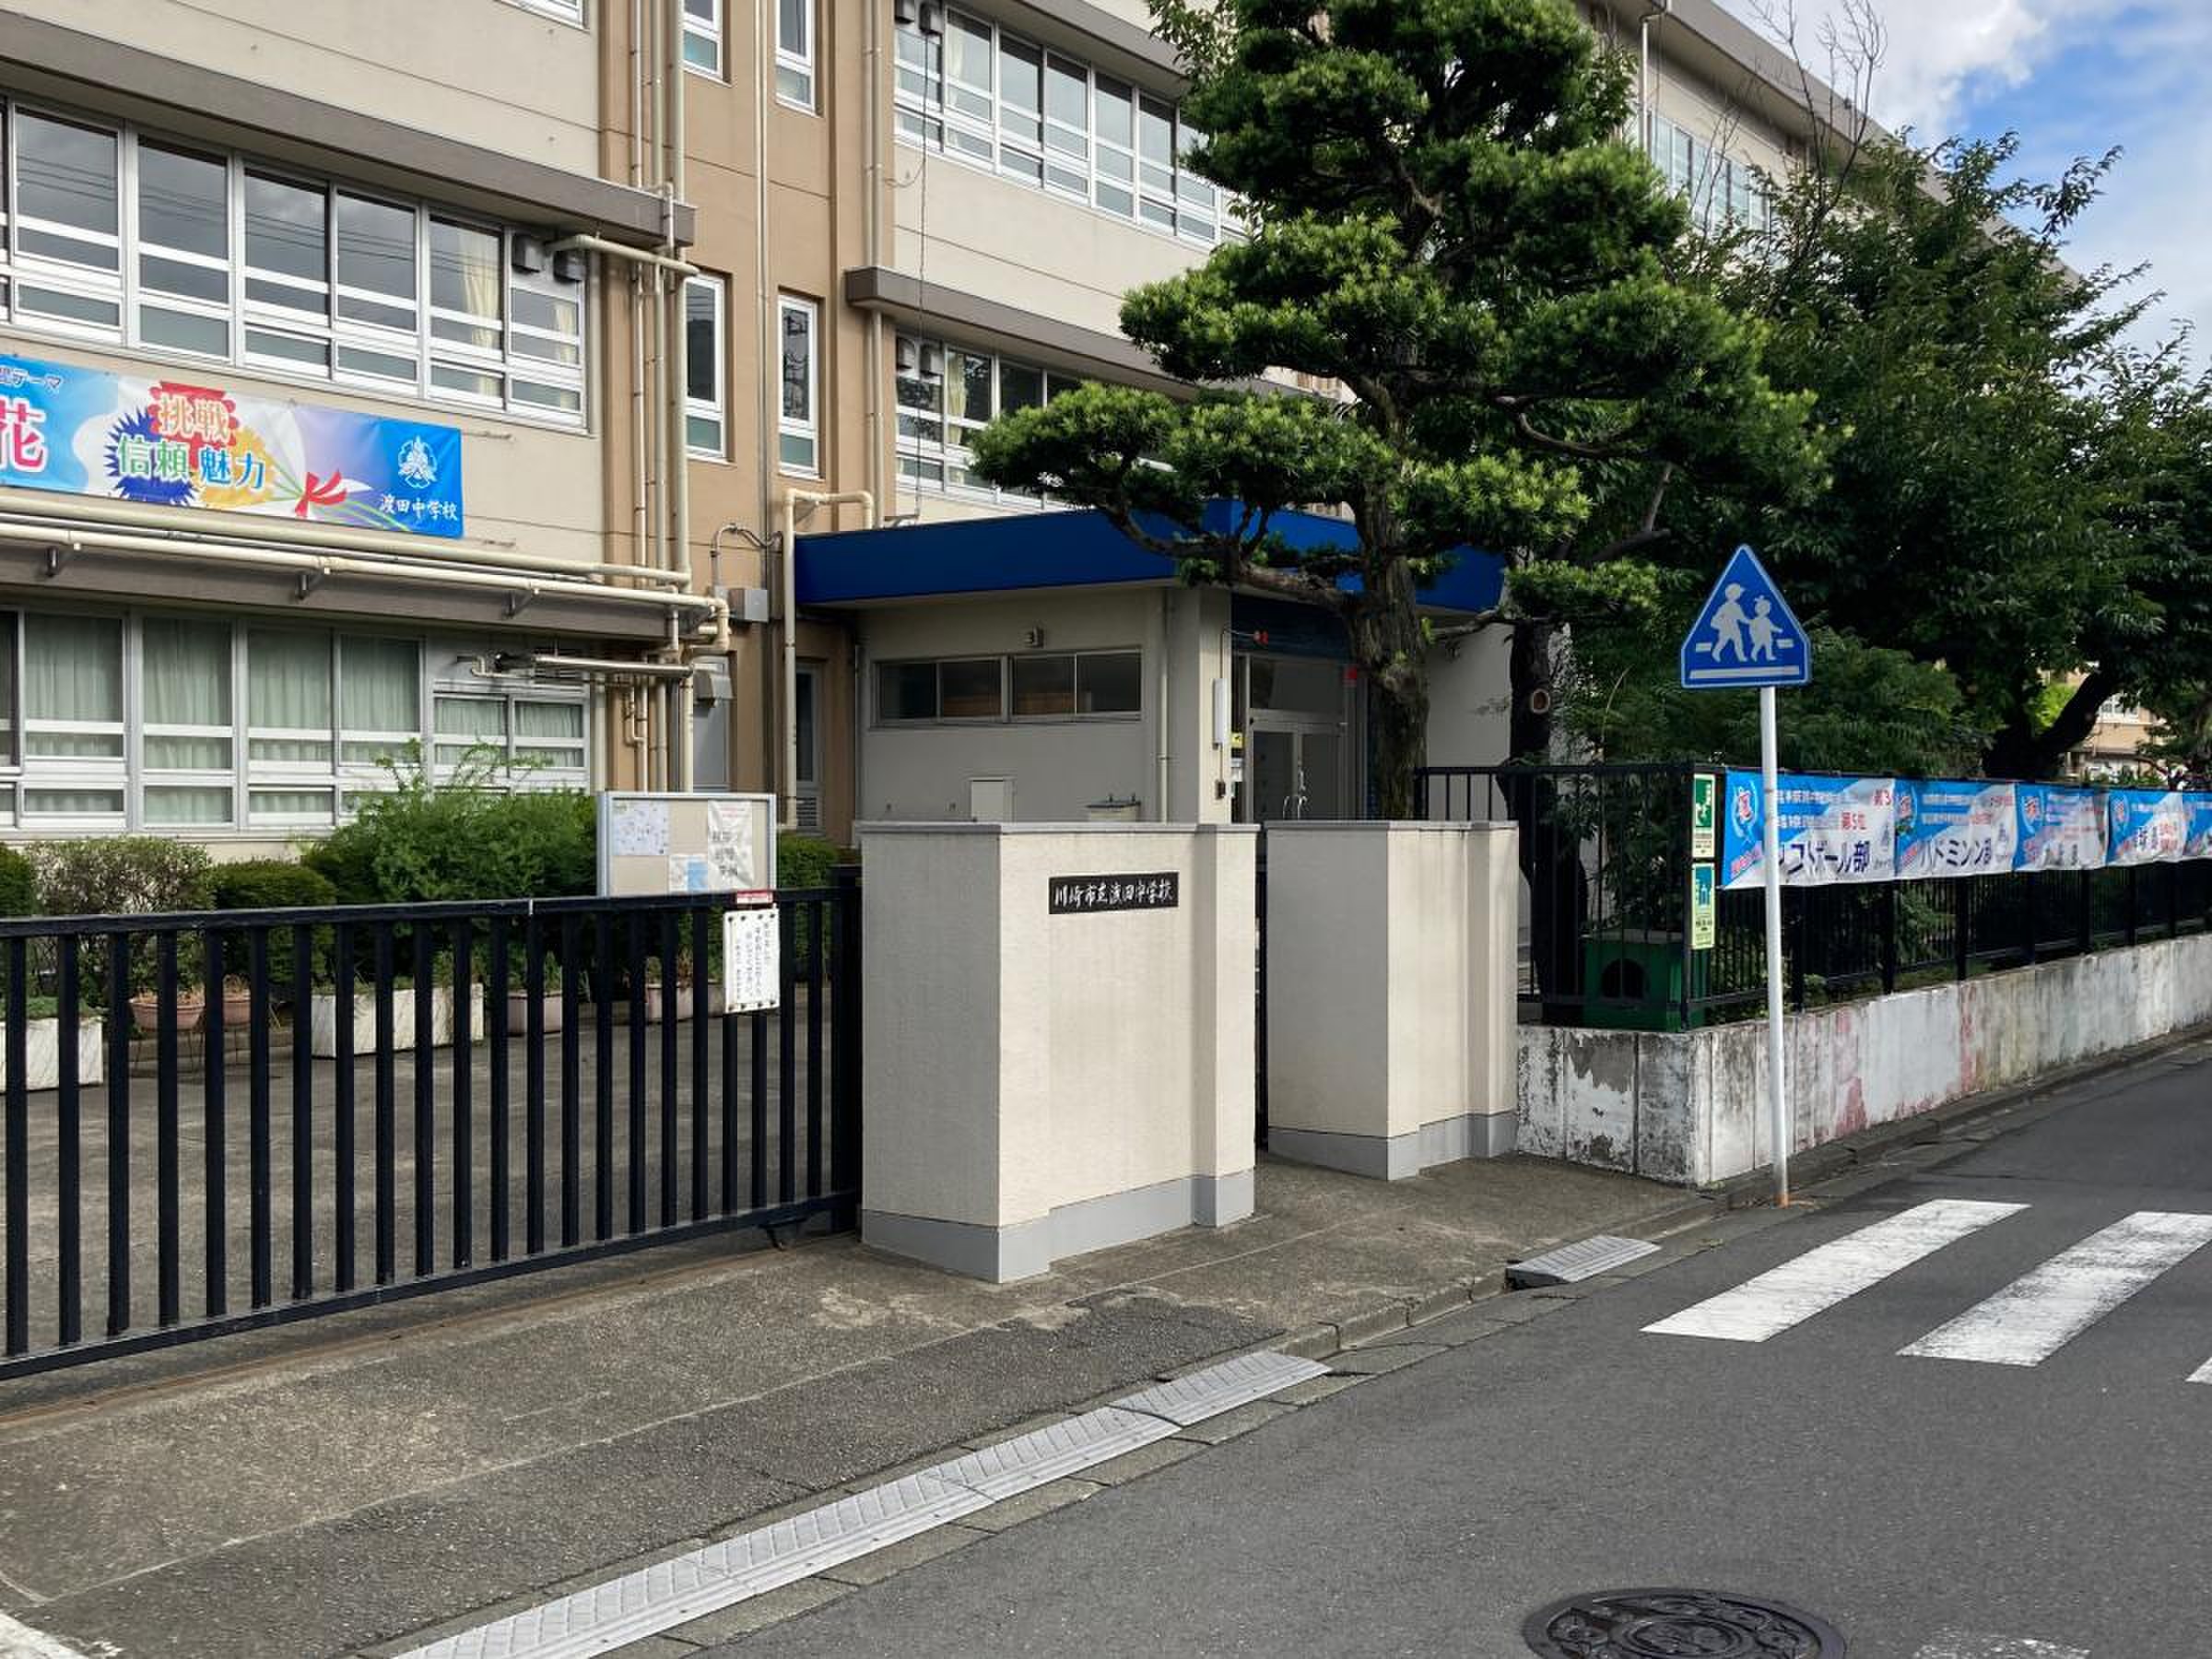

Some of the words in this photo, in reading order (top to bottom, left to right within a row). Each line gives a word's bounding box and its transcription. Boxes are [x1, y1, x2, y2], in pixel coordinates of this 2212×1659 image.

[0, 397, 46, 471] 花
[159, 394, 229, 442] 挑戦
[118, 433, 190, 480] 信頼
[199, 444, 265, 489] 魅力
[379, 493, 458, 521] 渡田中学校
[1054, 878, 1172, 908] 川崎市立渡田中学校
